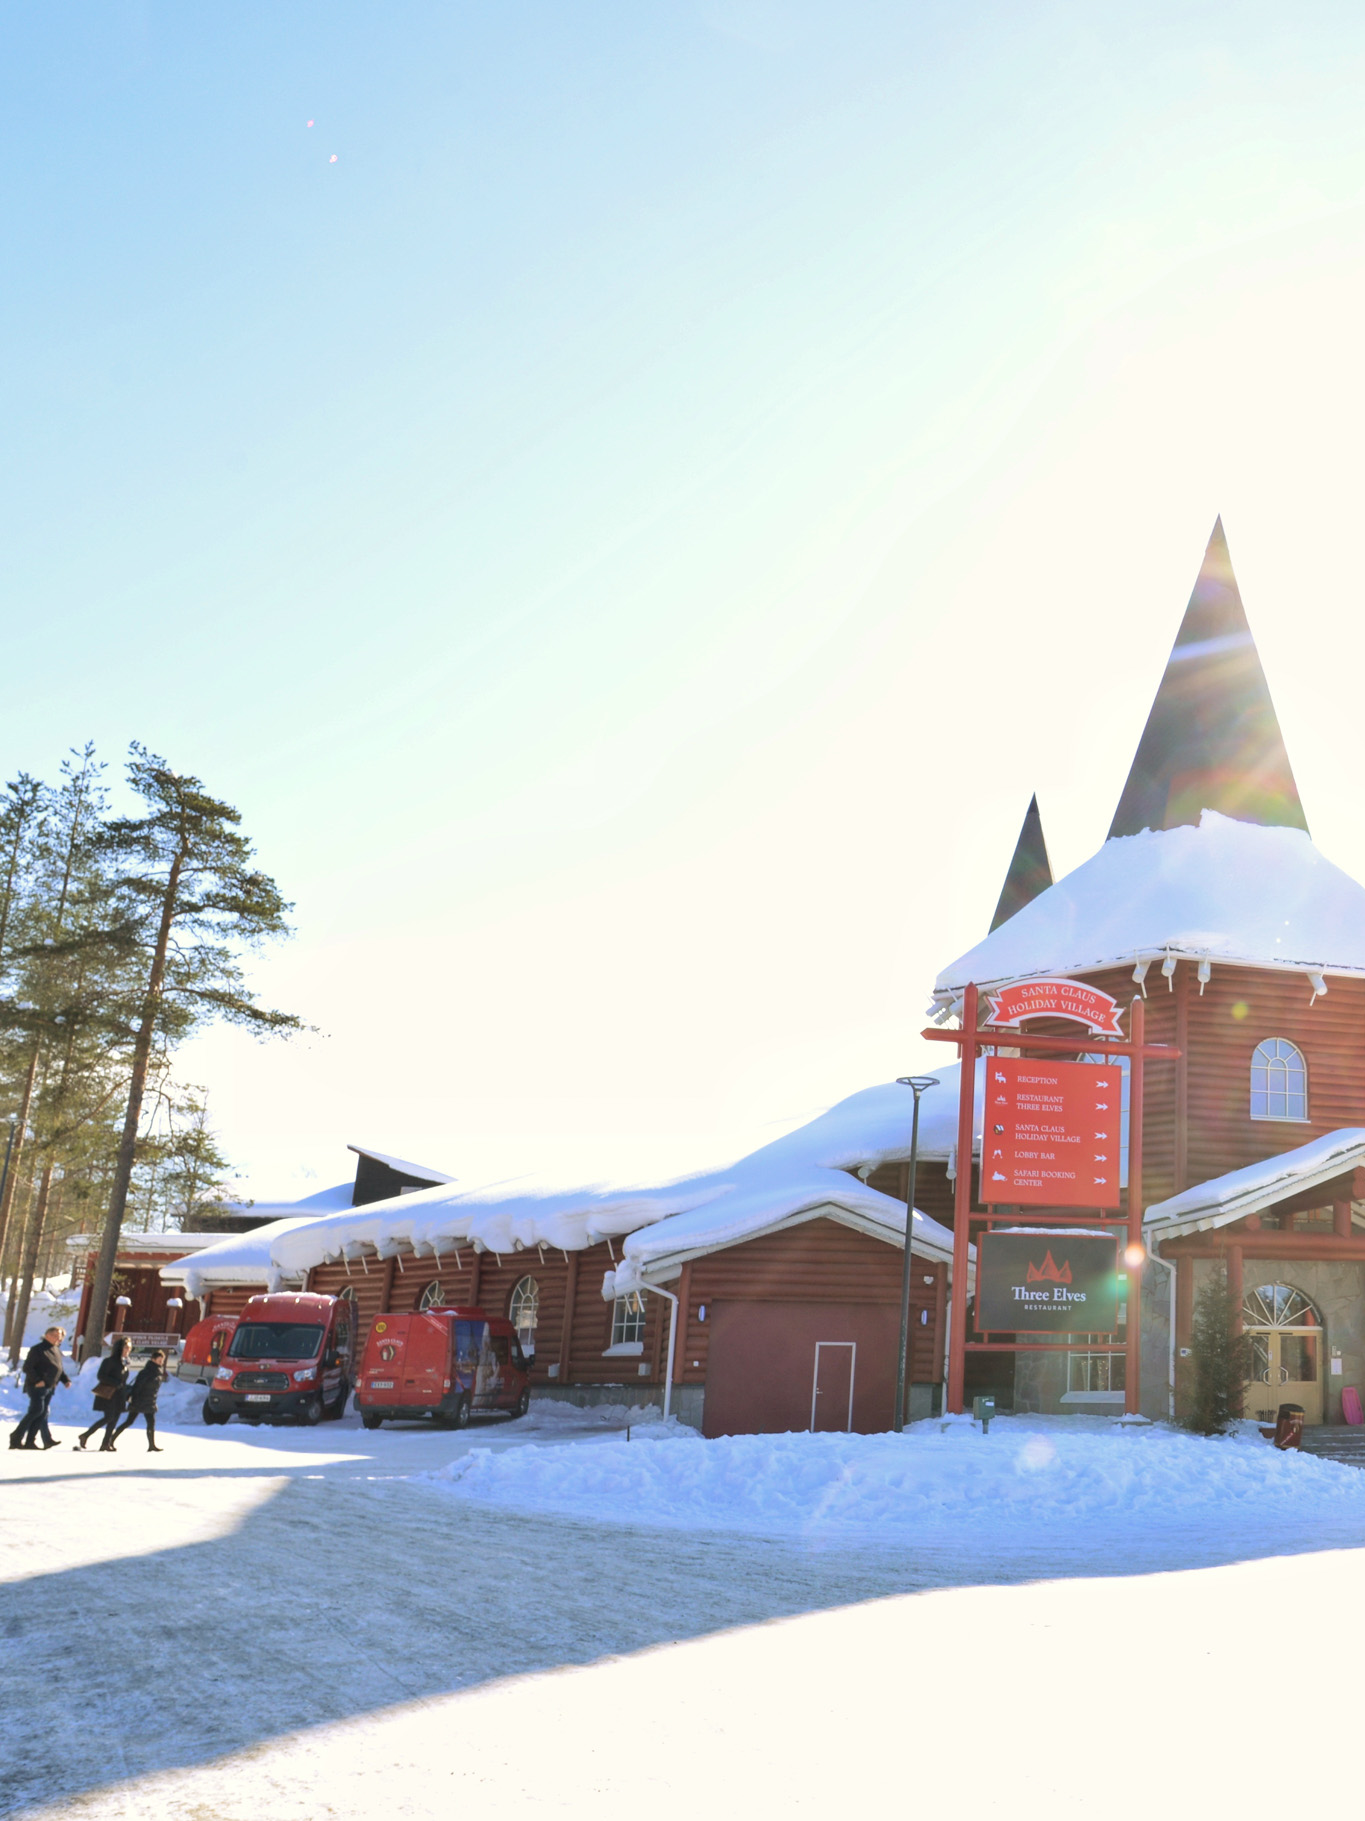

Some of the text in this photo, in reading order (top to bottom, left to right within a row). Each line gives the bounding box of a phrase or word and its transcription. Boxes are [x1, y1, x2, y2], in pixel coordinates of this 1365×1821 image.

[1021, 985, 1096, 1004] SANTA CLAUS
[1008, 1000, 1106, 1022] HOLIDAY VILLAGE
[1017, 1075, 1058, 1085] RECEPTION
[1016, 1093, 1064, 1103] RESTAURANT
[1017, 1103, 1040, 1111] THREE
[1042, 1103, 1063, 1112] ELVES
[1015, 1124, 1065, 1133] SANTA CLAUS
[1015, 1133, 1081, 1143] HOLIDAY VILLAGE
[1014, 1151, 1055, 1160] LOBBY BAR
[1014, 1169, 1076, 1180] SAFARI BOOKING
[1013, 1178, 1043, 1187] CENTER
[1011, 1286, 1087, 1302] Three Elves
